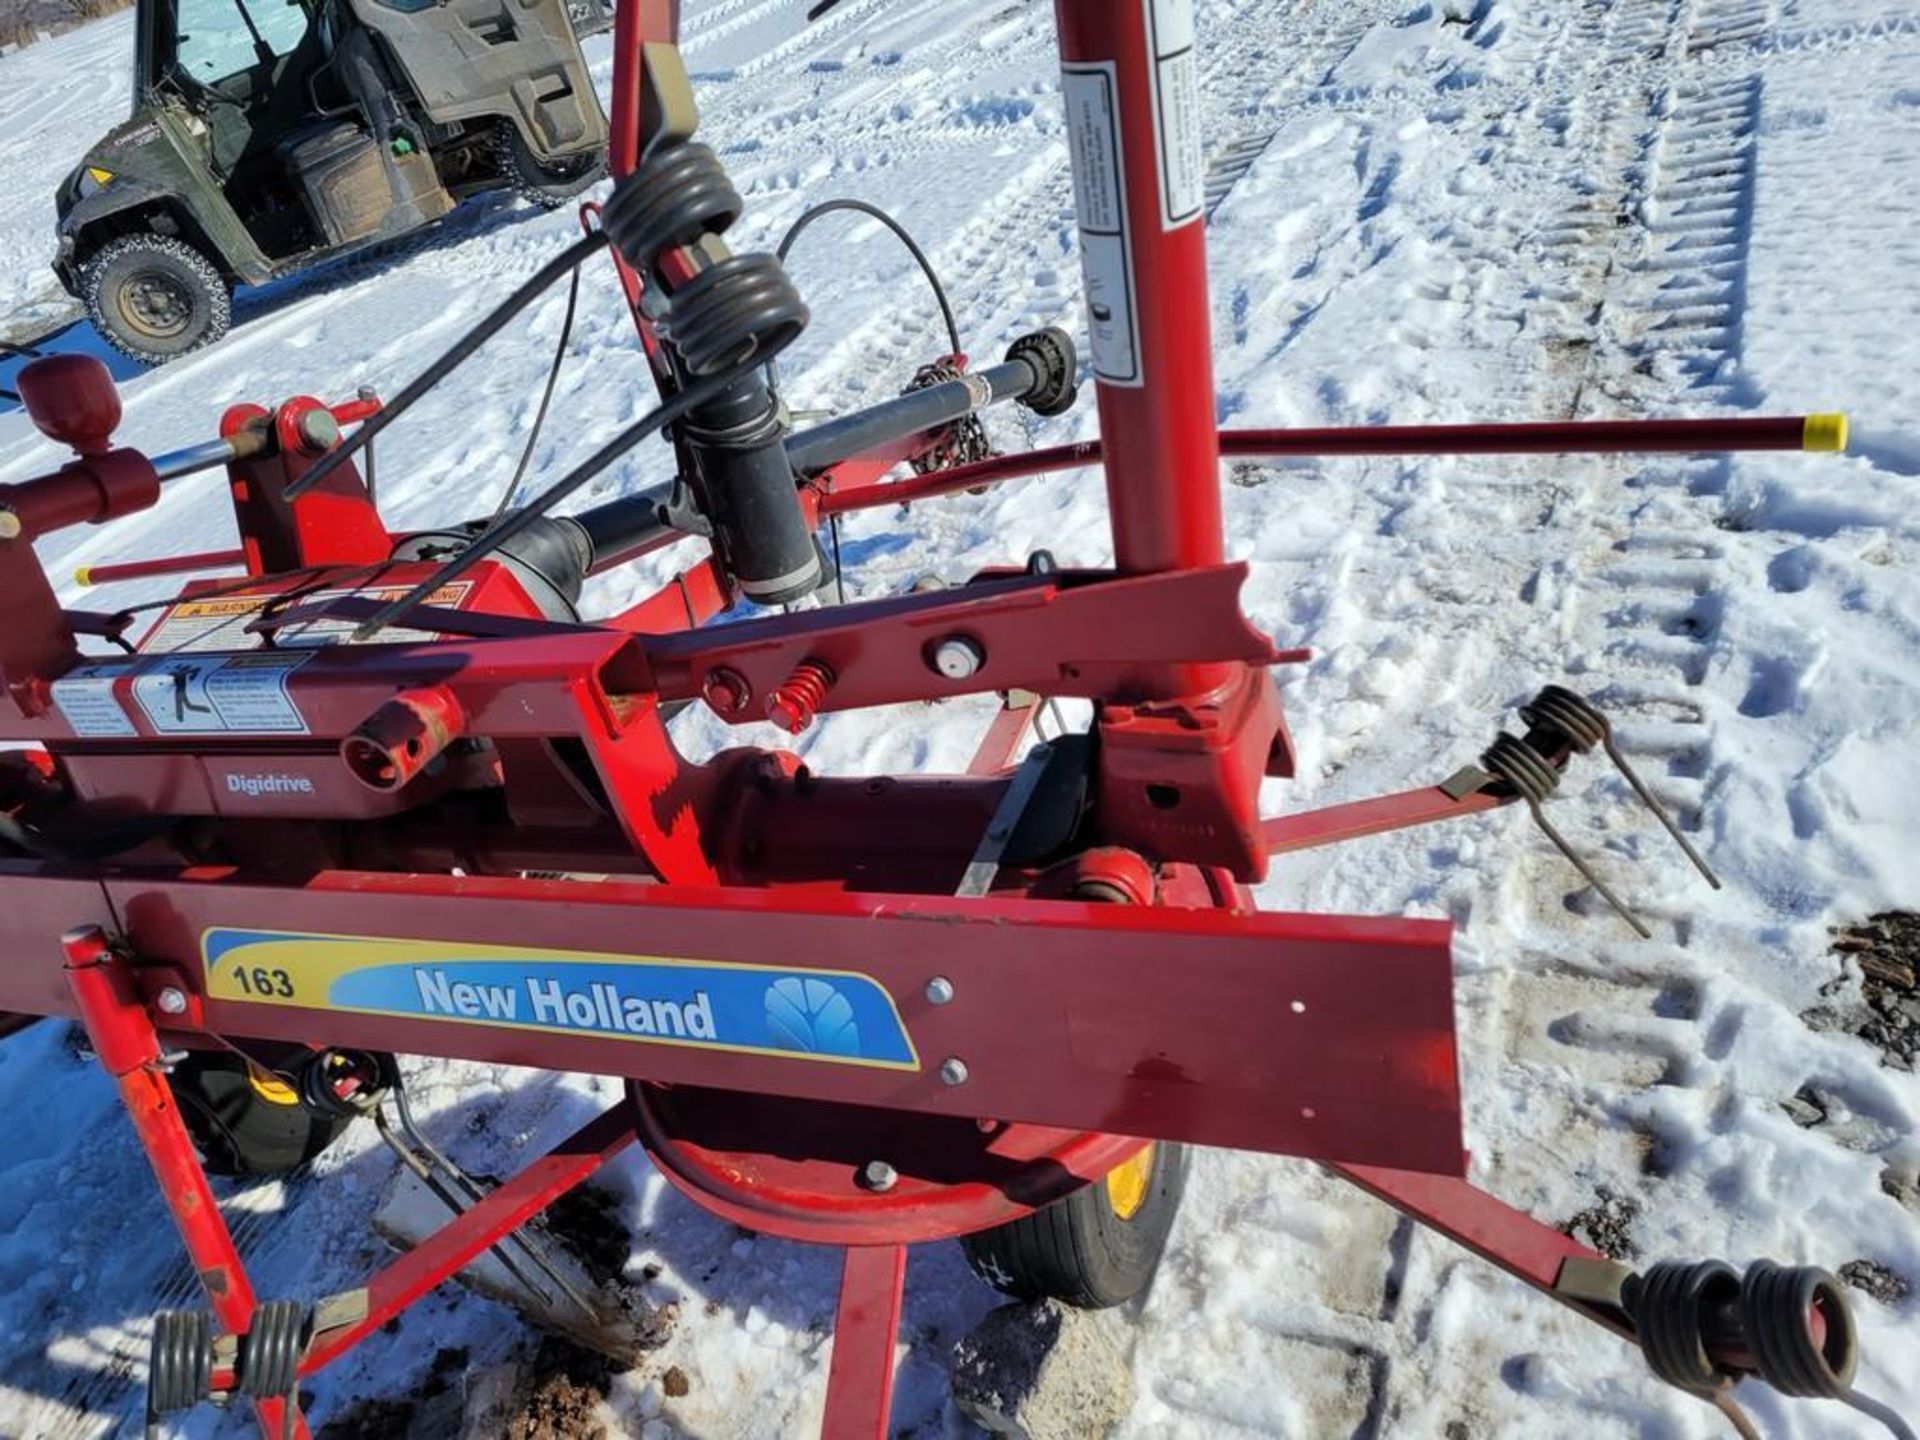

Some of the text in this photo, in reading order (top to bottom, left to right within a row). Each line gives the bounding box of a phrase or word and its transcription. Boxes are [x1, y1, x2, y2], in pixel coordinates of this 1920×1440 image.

[226, 774, 312, 796] Digidrive
[232, 965, 295, 998] 163
[414, 967, 718, 1040] New Holland
